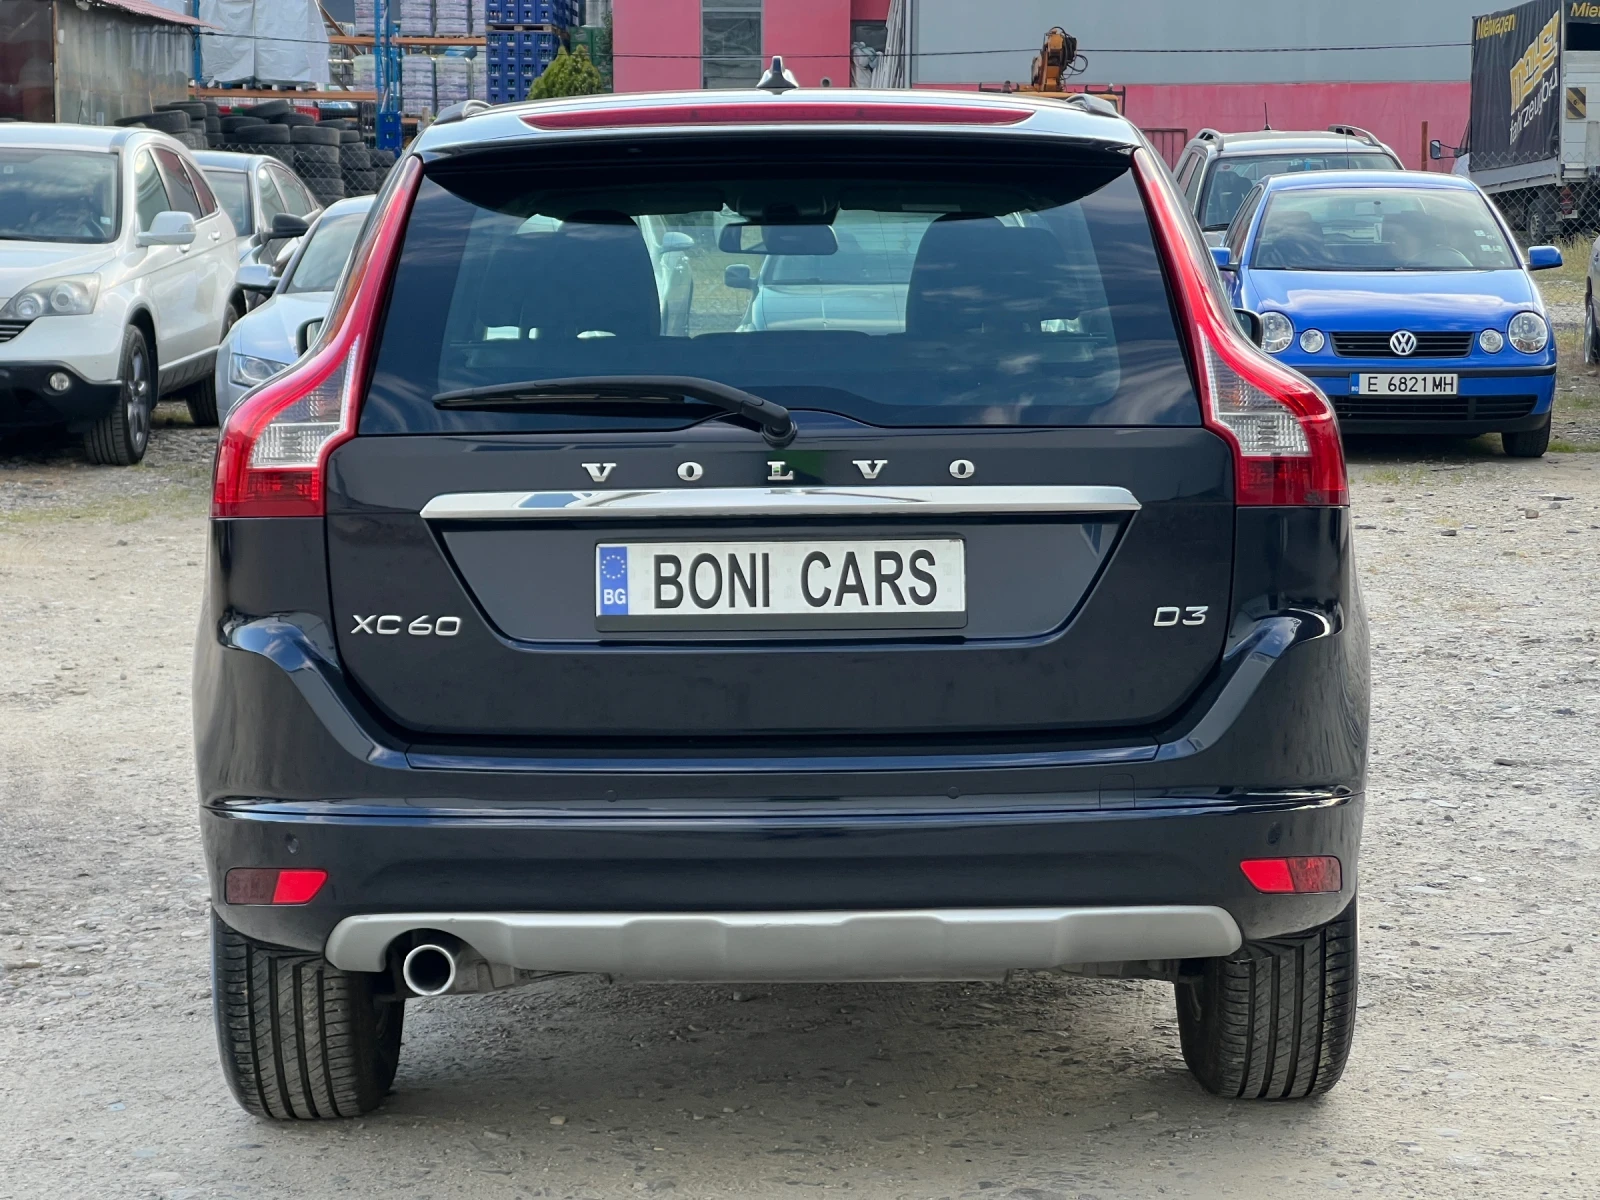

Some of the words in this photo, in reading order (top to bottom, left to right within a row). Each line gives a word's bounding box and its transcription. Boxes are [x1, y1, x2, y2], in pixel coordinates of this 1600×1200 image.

[1570, 2, 1600, 18] Mie
[1367, 376, 1378, 392] E
[1388, 376, 1427, 392] 6821
[1432, 376, 1454, 392] MH
[581, 458, 976, 483] VOLVO
[603, 588, 627, 605] BG
[653, 552, 770, 610] BONI
[800, 549, 938, 607] CARS
[1153, 605, 1209, 627] D3
